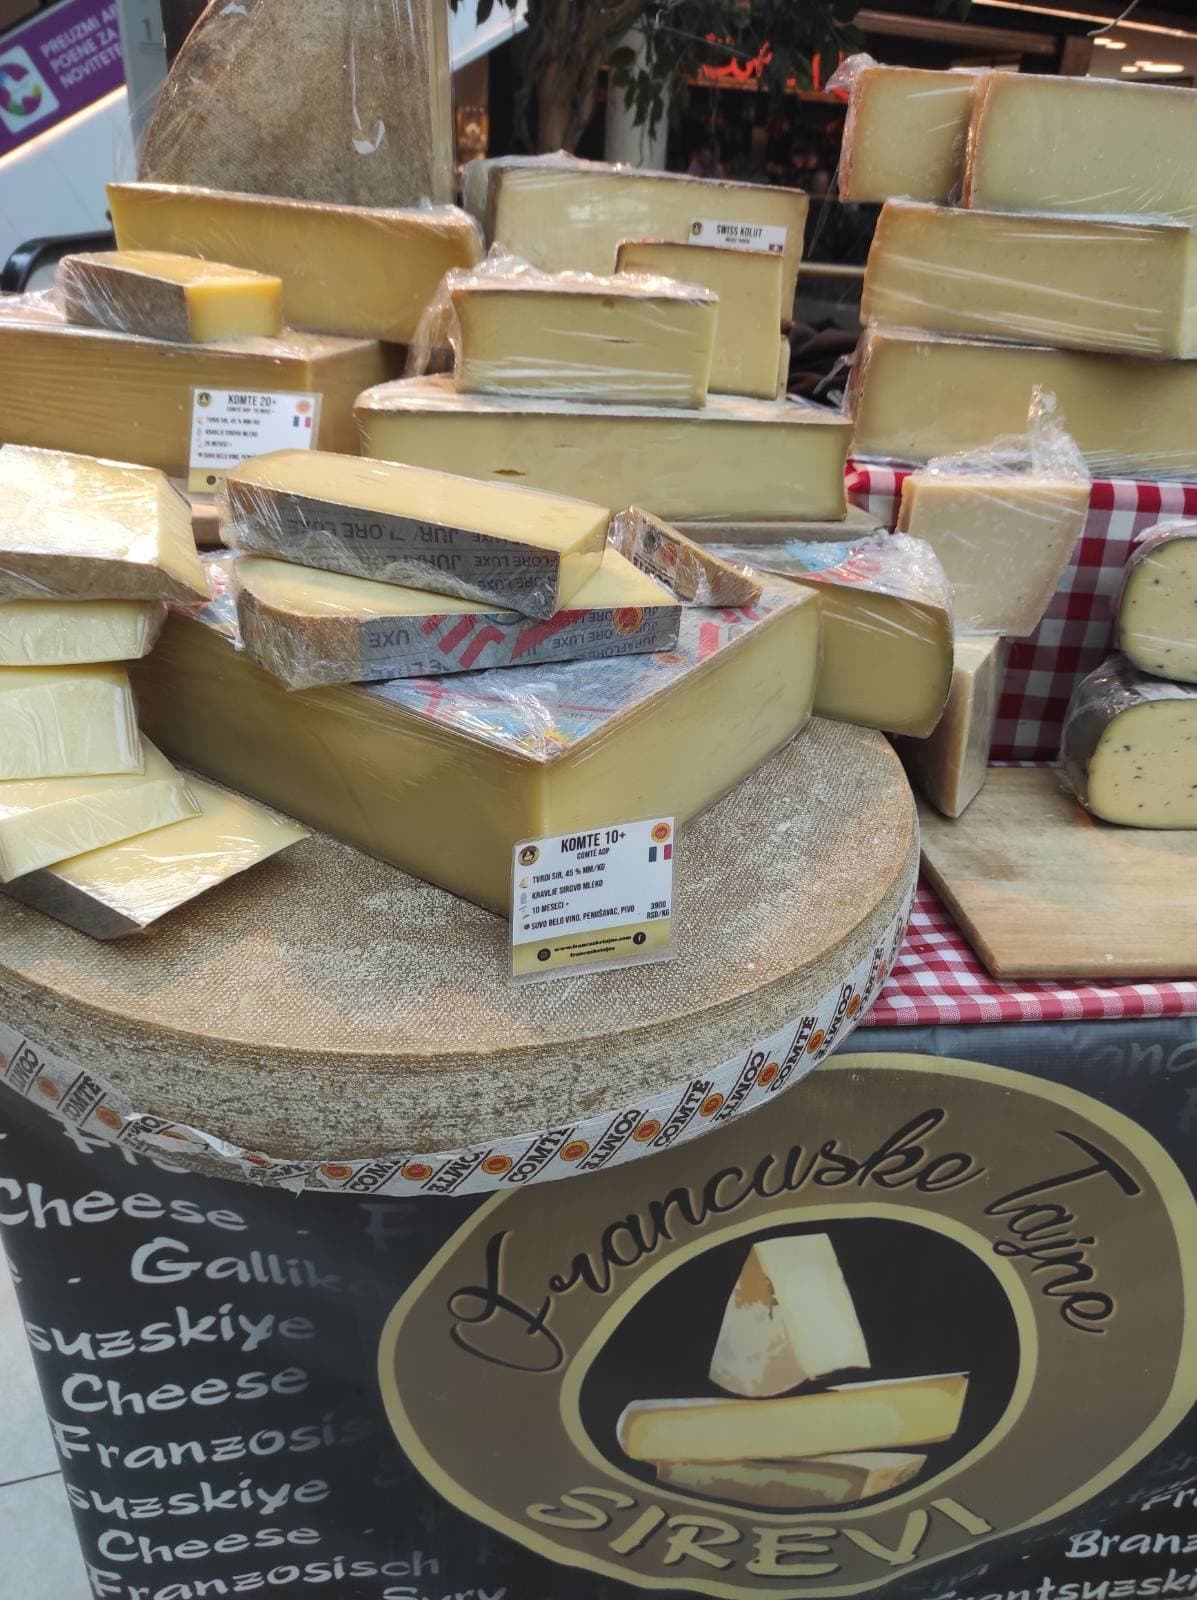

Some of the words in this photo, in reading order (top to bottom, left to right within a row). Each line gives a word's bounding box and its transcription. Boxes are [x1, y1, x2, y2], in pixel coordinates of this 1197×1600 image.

[40, 16, 101, 57] PREUZMI
[50, 38, 97, 74] POENE
[97, 27, 118, 45] ZA
[228, 394, 257, 406] KOMTE
[473, 555, 509, 567] LUXE
[553, 633, 585, 649] LUXE
[561, 832, 600, 853] KOMTE
[605, 829, 626, 845] 10+
[577, 847, 597, 860] COMTÉ
[533, 874, 551, 884] TVRDI
[552, 871, 564, 881] SIR,
[565, 868, 574, 877] 45
[582, 863, 606, 874] MM/KG
[532, 887, 558, 900] KRAVLJE
[559, 883, 581, 894] SIROVO
[583, 879, 603, 890] MLEKO
[531, 920, 547, 930] SUVO
[548, 916, 565, 927] BELO
[565, 913, 582, 924] VINO,
[582, 907, 620, 919] PENUŠAVAC,
[620, 904, 635, 914] PIVO
[532, 906, 540, 914] 10
[541, 901, 564, 913] MESECI
[646, 908, 670, 919] RSD/KG
[650, 900, 667, 910] 3900
[0, 1177, 248, 1231] Cheese
[448, 1107, 985, 1374] Francuske
[984, 1130, 1141, 1333] Tajne
[62, 1367, 310, 1416] Cheese
[525, 1486, 993, 1577] SIREVI
[98, 1527, 321, 1564] Cheese
[85, 1550, 440, 1600] Franzosisch
